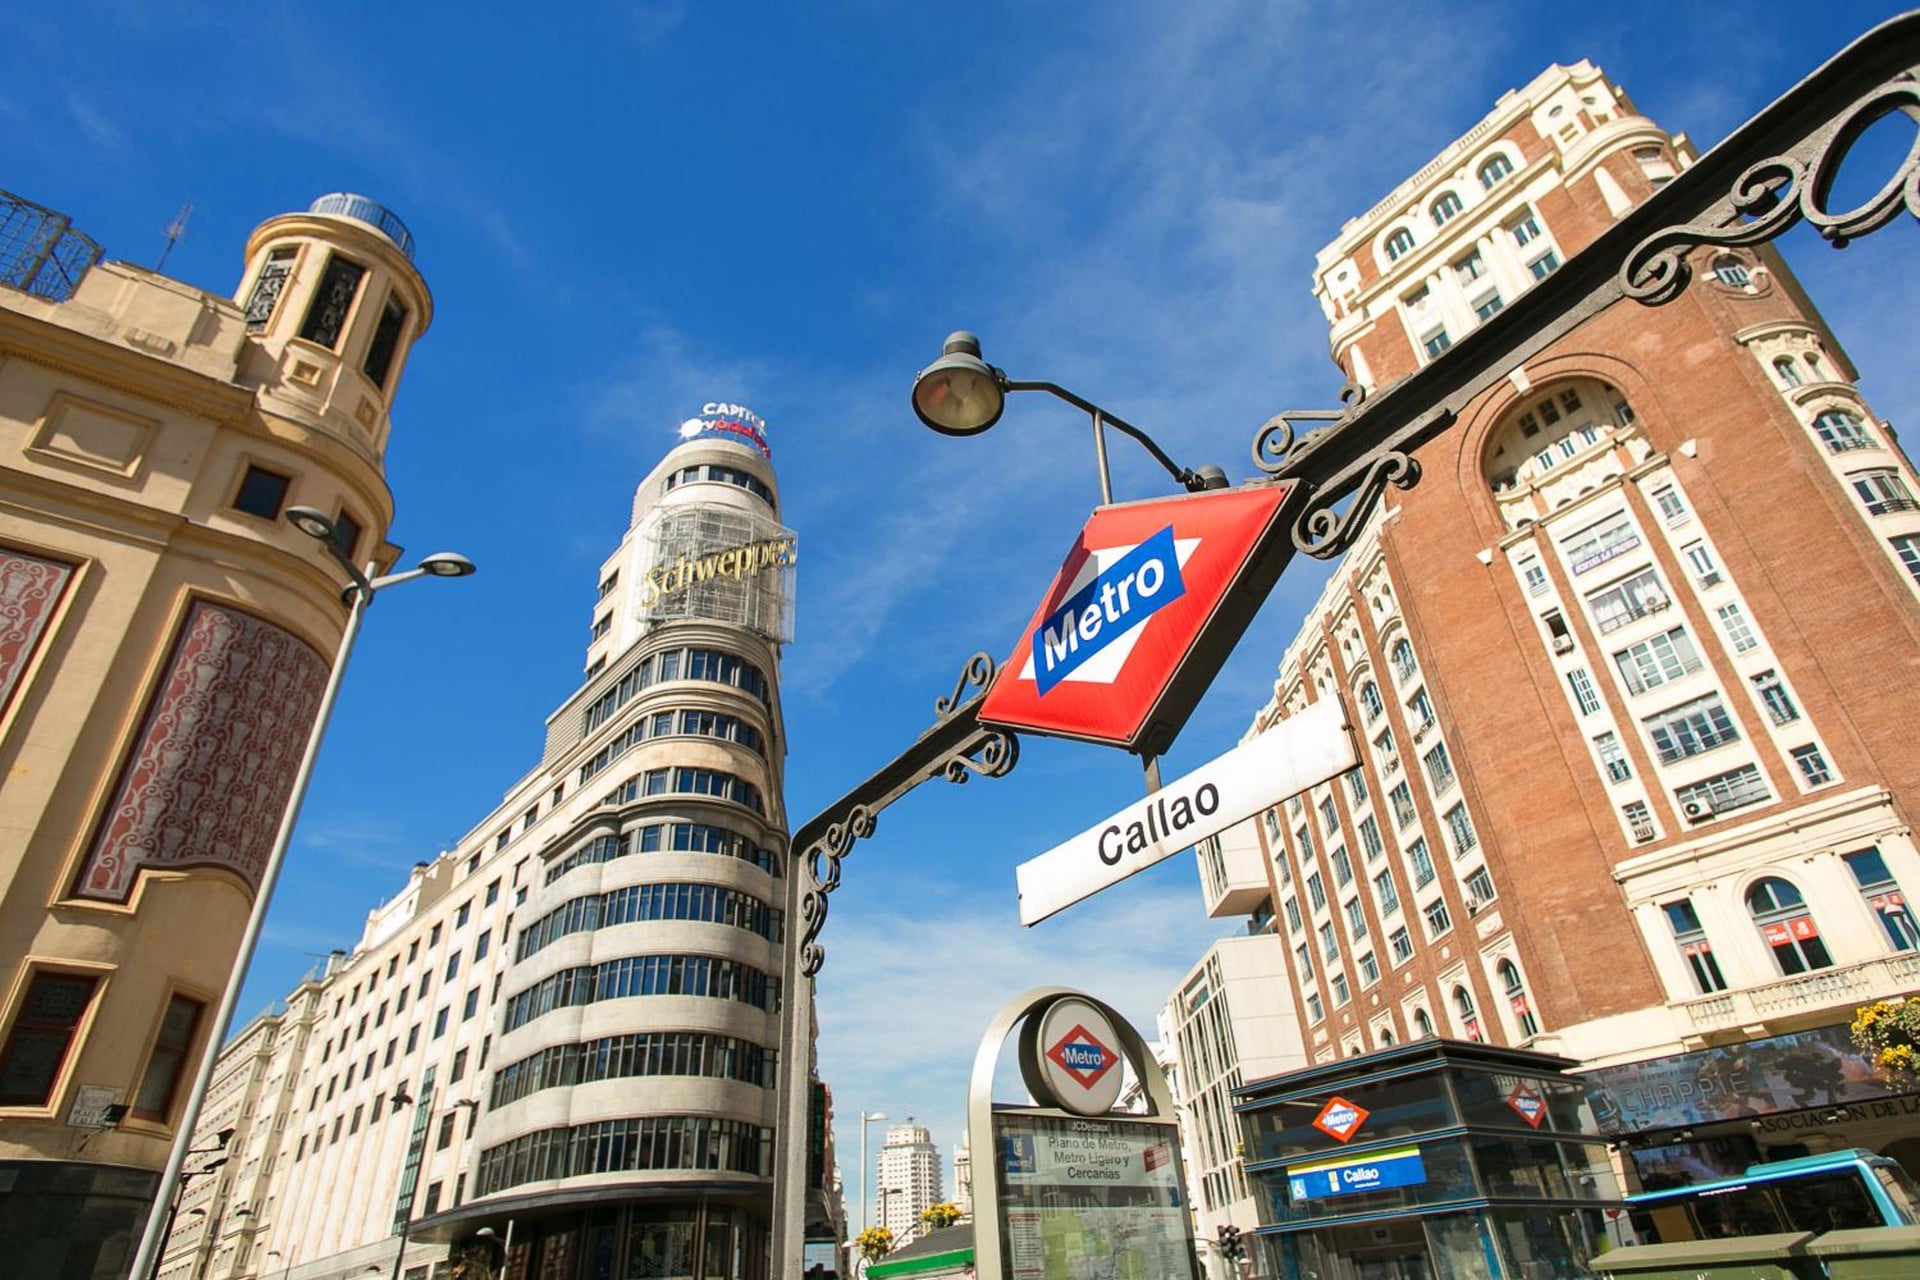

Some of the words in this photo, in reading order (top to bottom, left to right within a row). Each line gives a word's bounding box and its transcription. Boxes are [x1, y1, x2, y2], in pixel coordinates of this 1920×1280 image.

[641, 538, 797, 608] Schweppes
[1043, 558, 1165, 672] Metro
[1098, 782, 1220, 866] Callao
[1064, 1047, 1102, 1066] Metro
[1618, 1072, 1751, 1112] CHAPPIE
[1872, 1099, 1899, 1119] DE
[1325, 1112, 1355, 1126] Metro
[1049, 1136, 1080, 1149] Plano
[1082, 1138, 1096, 1149] de
[1054, 1151, 1086, 1164] Metro
[1089, 1152, 1121, 1167] Ligero
[1122, 1155, 1130, 1168] y
[1343, 1167, 1379, 1183] Callao
